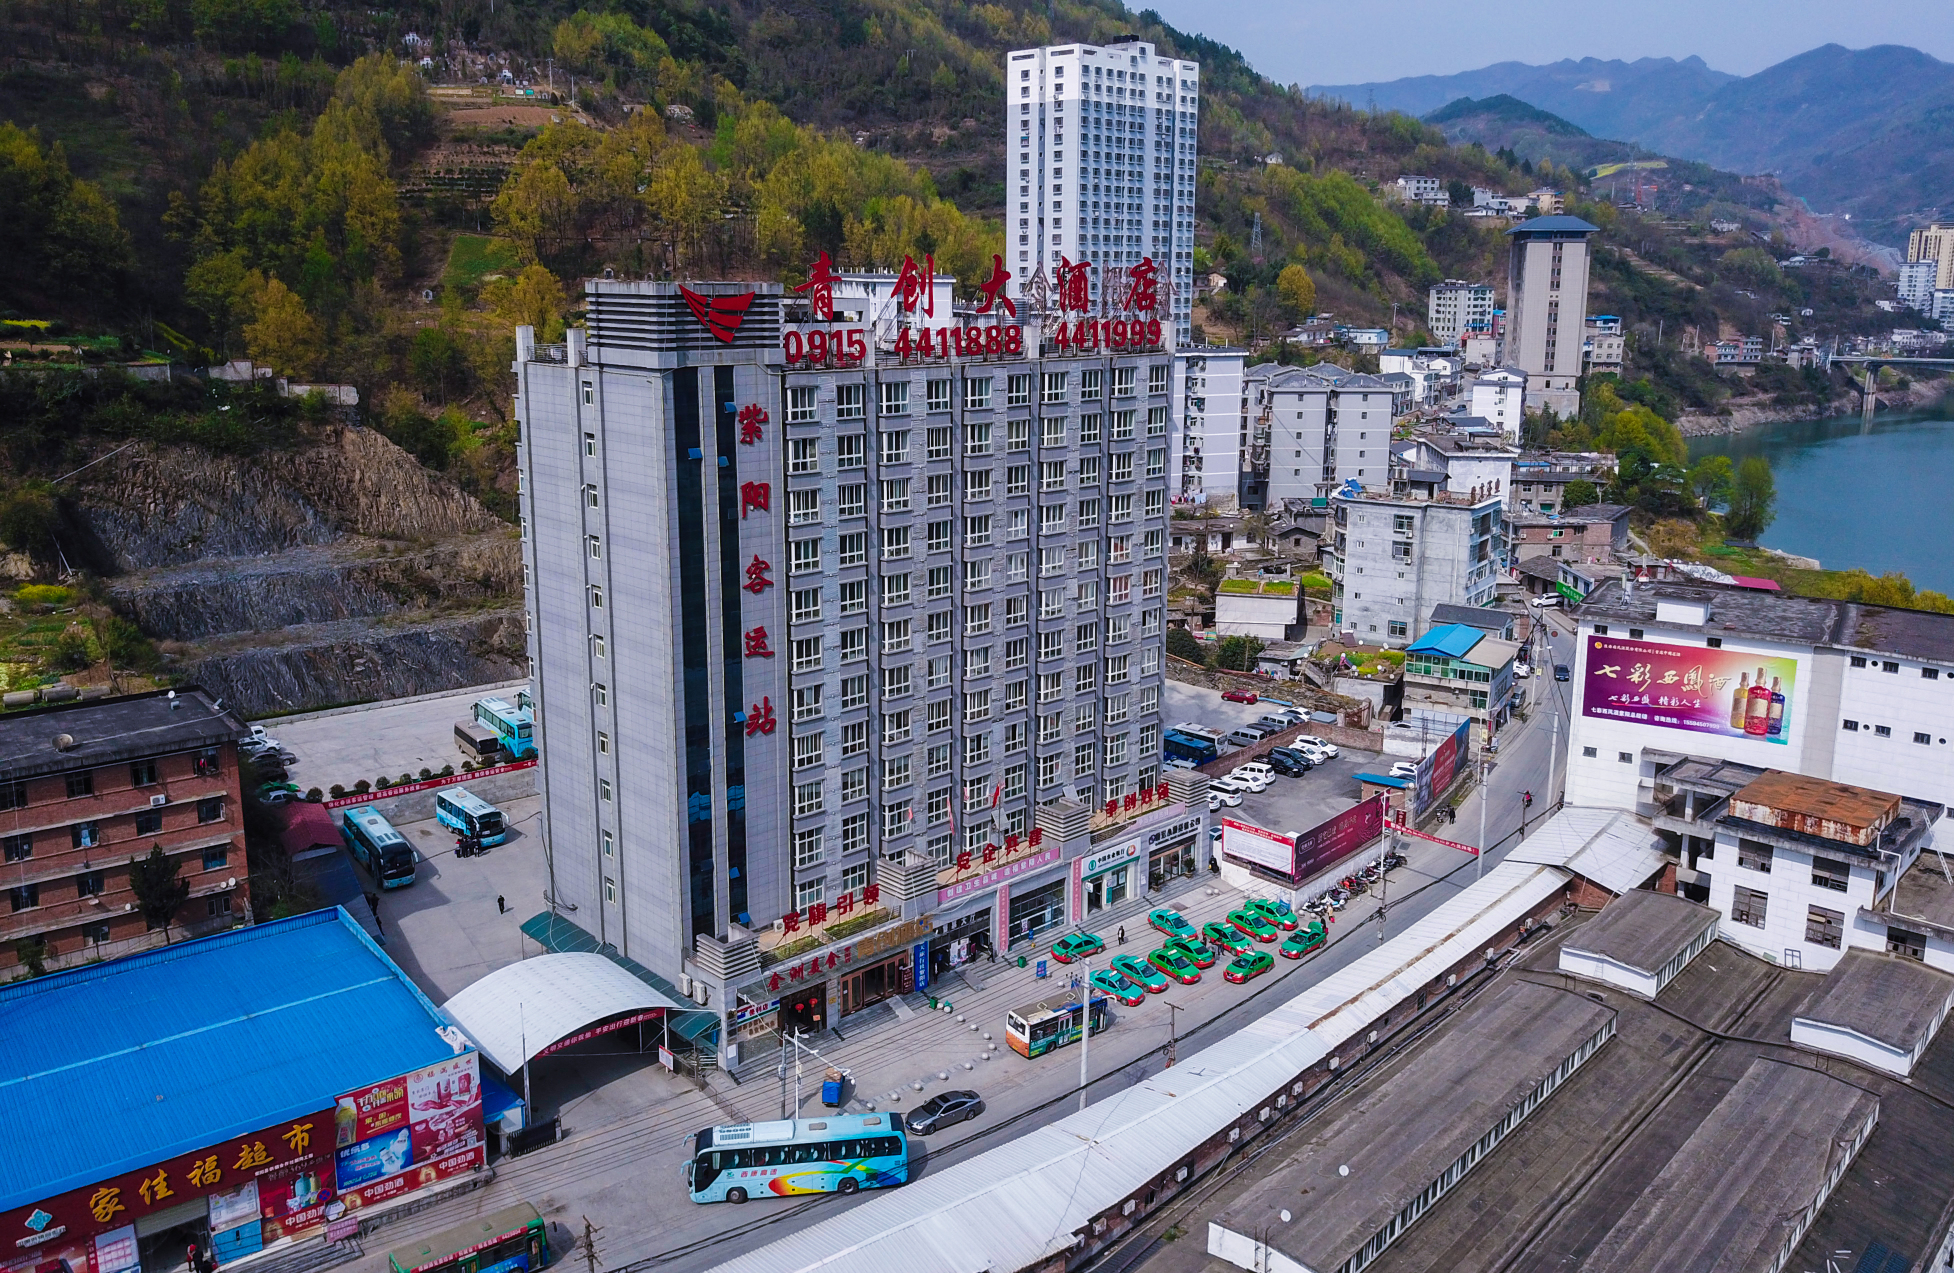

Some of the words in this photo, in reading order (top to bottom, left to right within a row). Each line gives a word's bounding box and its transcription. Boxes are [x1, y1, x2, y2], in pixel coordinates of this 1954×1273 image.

[793, 250, 1160, 320] 青创大酒店
[784, 329, 867, 364] 0915
[894, 324, 1022, 359] 4411888
[1055, 319, 1161, 350] 4411999
[738, 403, 777, 736] 紫阳客运站
[1657, 695, 1701, 708] 精彩人生
[1105, 782, 1170, 818] 争创双强
[956, 827, 1043, 874] 党企共建
[783, 883, 880, 936] 党旗引领
[90, 1123, 314, 1223] 家佳福超市
[439, 1151, 475, 1171] 中国劲酒
[364, 1177, 404, 1198] 中国劲酒
